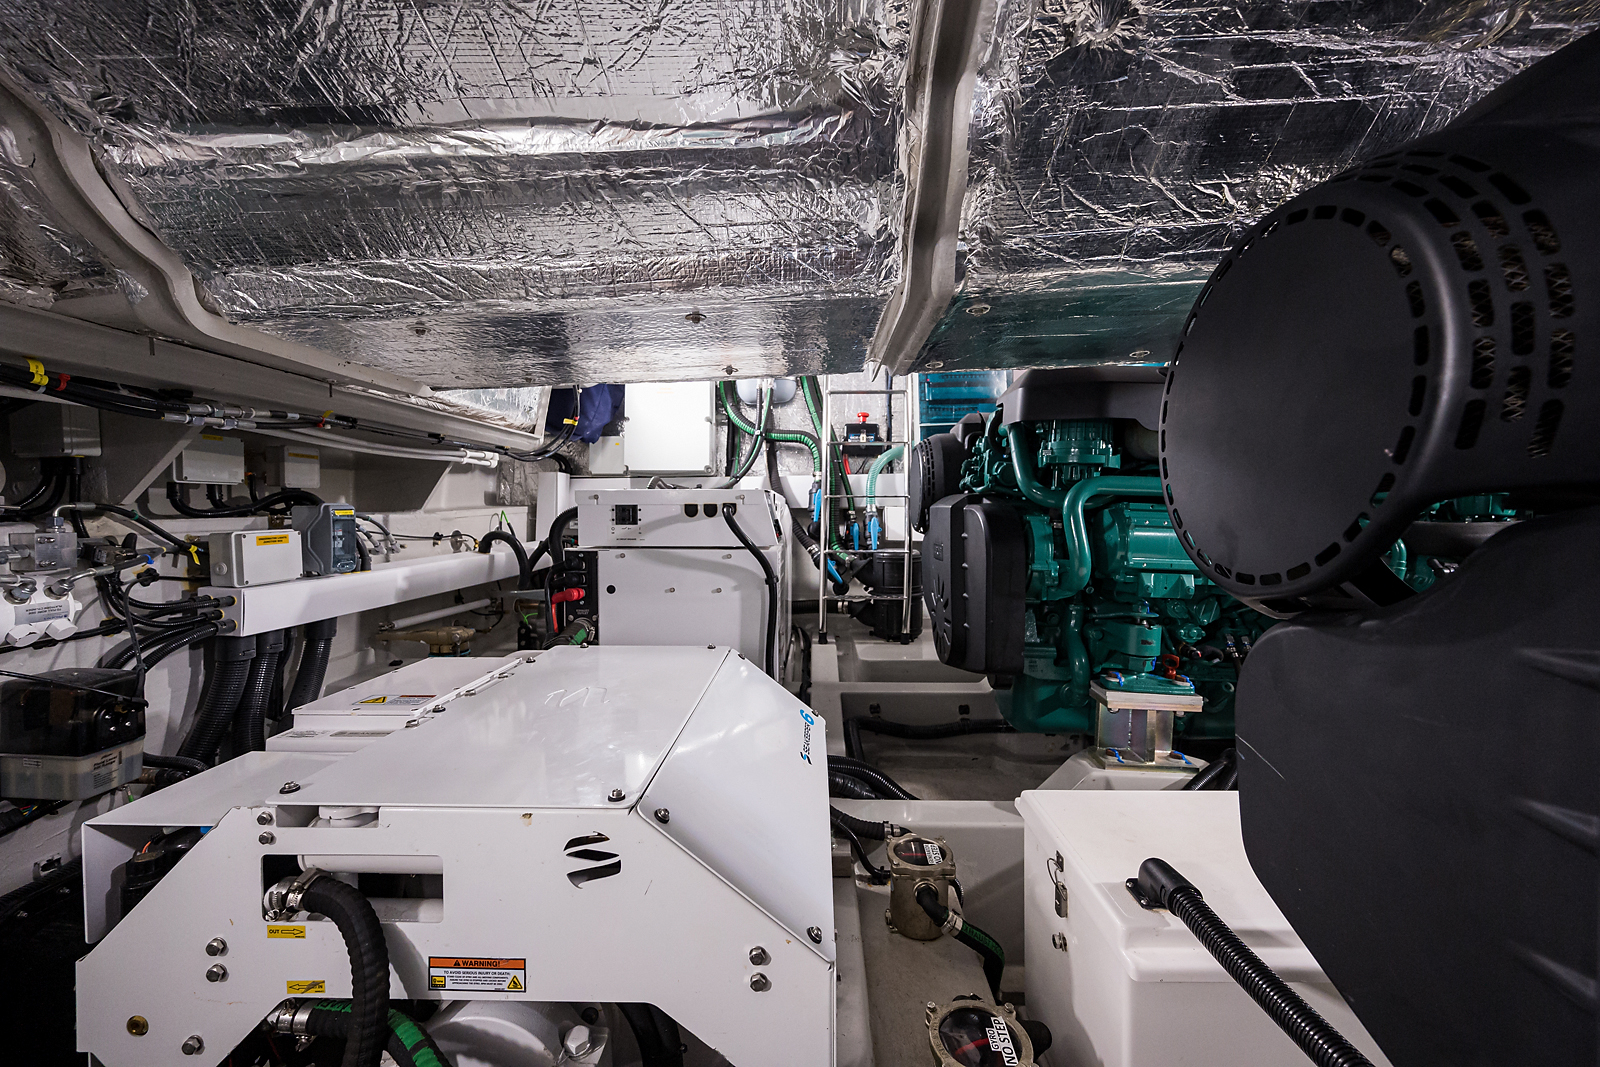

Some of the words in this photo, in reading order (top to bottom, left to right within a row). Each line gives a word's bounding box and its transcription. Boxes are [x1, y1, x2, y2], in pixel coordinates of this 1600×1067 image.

[800, 709, 814, 726] 6
[988, 1029, 1000, 1050] GYRO
[993, 1018, 1010, 1044] STEP
[1002, 1046, 1018, 1065] NO
